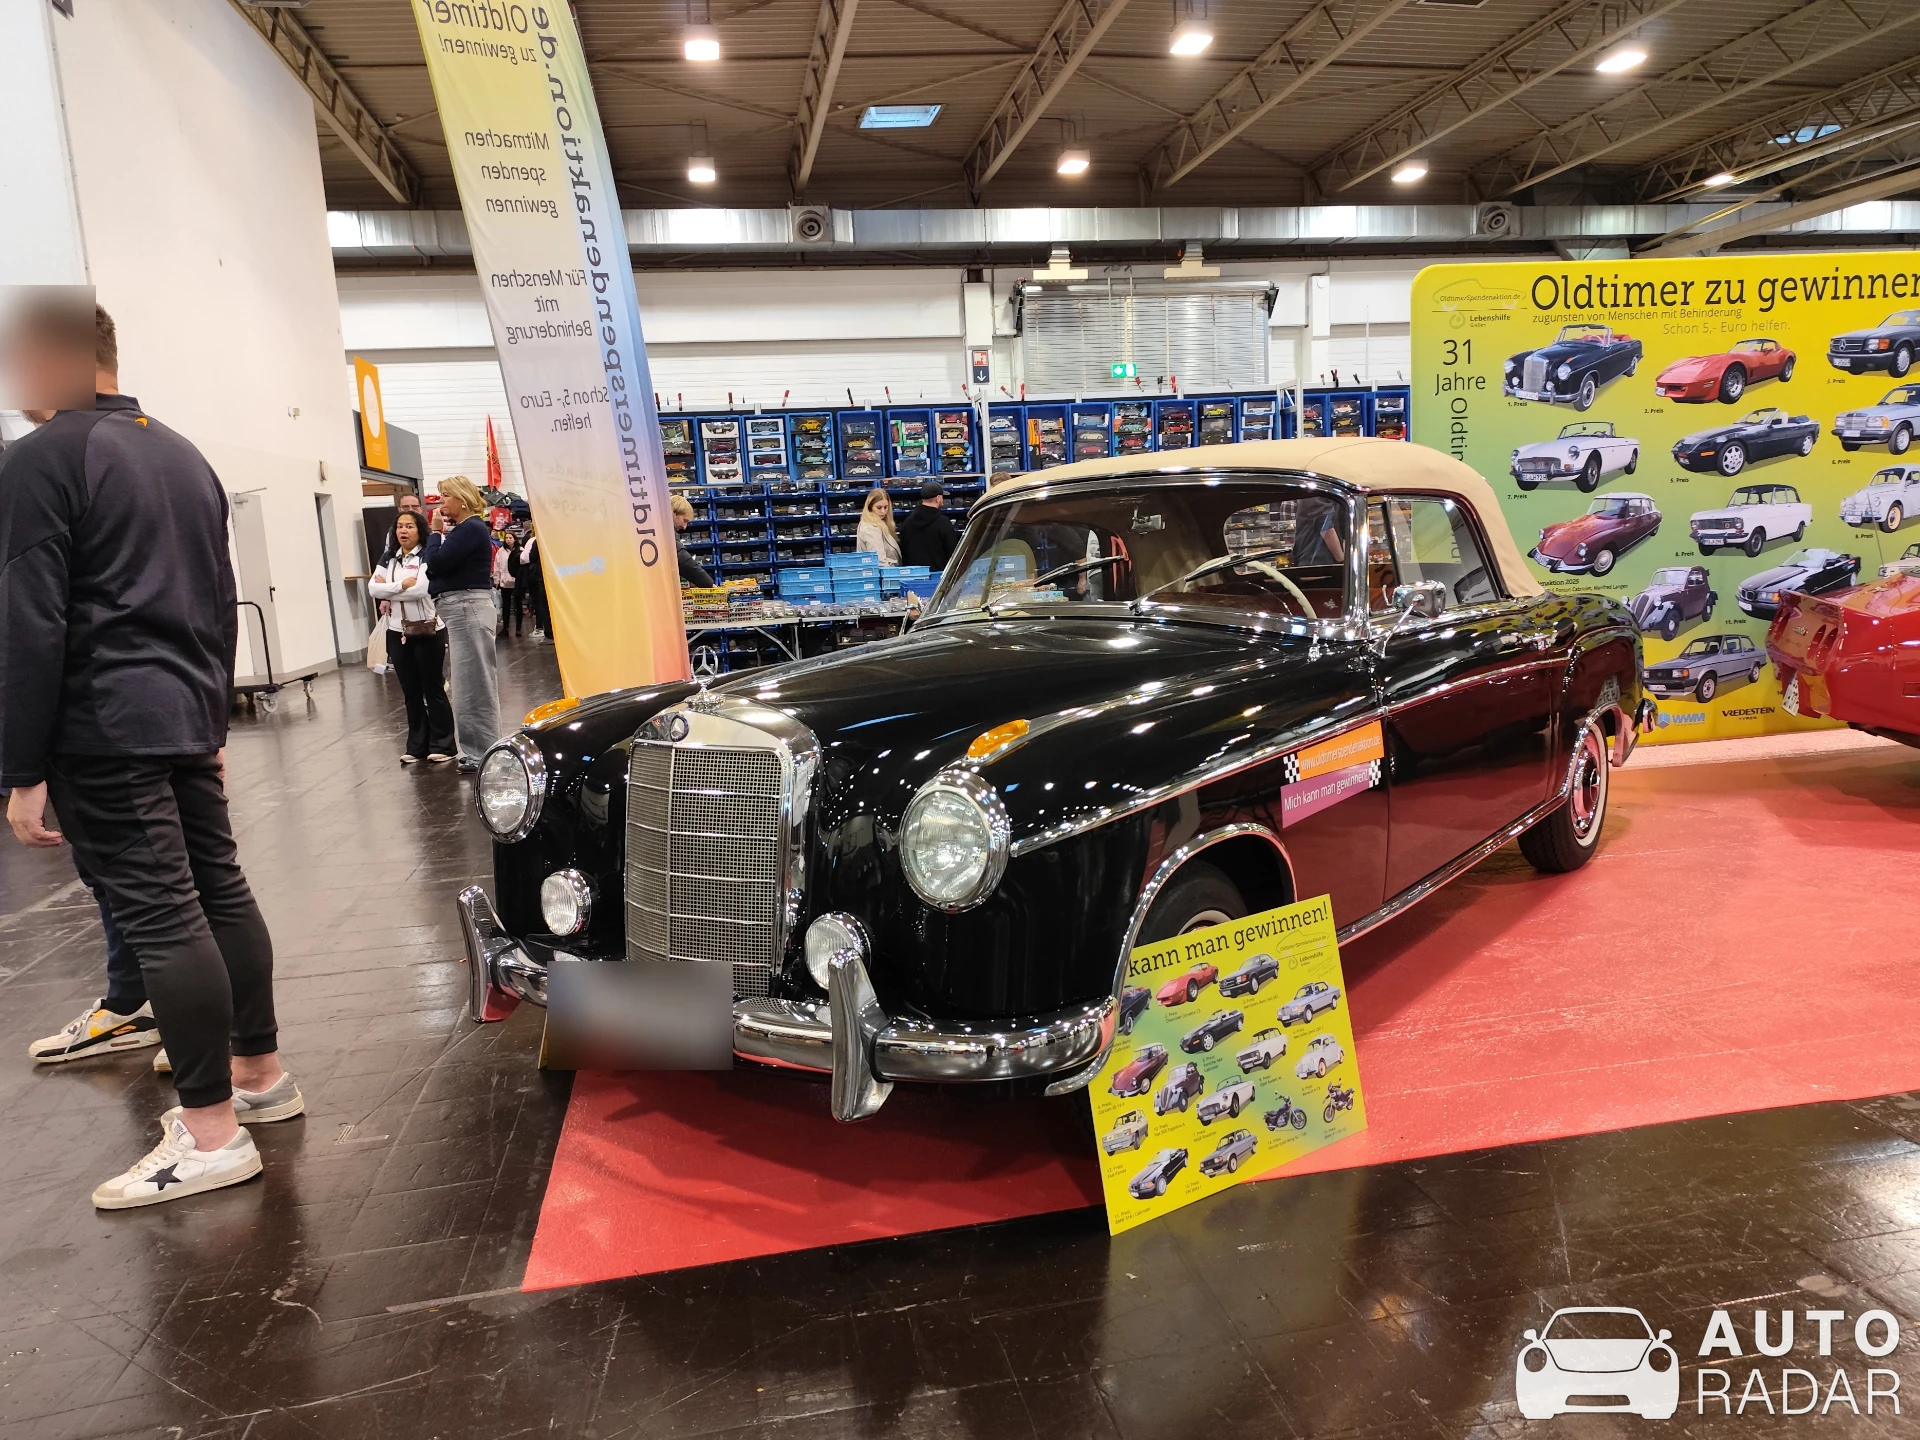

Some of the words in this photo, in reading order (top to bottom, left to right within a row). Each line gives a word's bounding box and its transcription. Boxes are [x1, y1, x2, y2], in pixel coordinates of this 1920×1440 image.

[1531, 273, 1695, 310] Oldtimer
[1705, 279, 1746, 306] zu
[1470, 314, 1511, 322] Lebenshilfe
[1533, 311, 1585, 325] zugunsten
[1587, 312, 1606, 321] von
[1608, 310, 1658, 321] Menschen
[1661, 308, 1678, 319] mit
[1680, 307, 1742, 320] Behinderung
[1663, 323, 1699, 335] Schon
[1721, 321, 1747, 333] Euro
[1751, 319, 1790, 332] helfen.
[1442, 339, 1472, 366] 31
[1433, 372, 1486, 396] Jahre
[1672, 713, 1706, 724] WWM
[1721, 706, 1776, 717] VREDESTEIN
[1284, 796, 1301, 811] Mich
[1302, 788, 1320, 804] kann
[1321, 784, 1336, 798] man
[1337, 768, 1369, 795] gewinnen!
[1128, 949, 1181, 978] kann
[1185, 934, 1230, 961] man
[1234, 901, 1329, 951] gewinnen!
